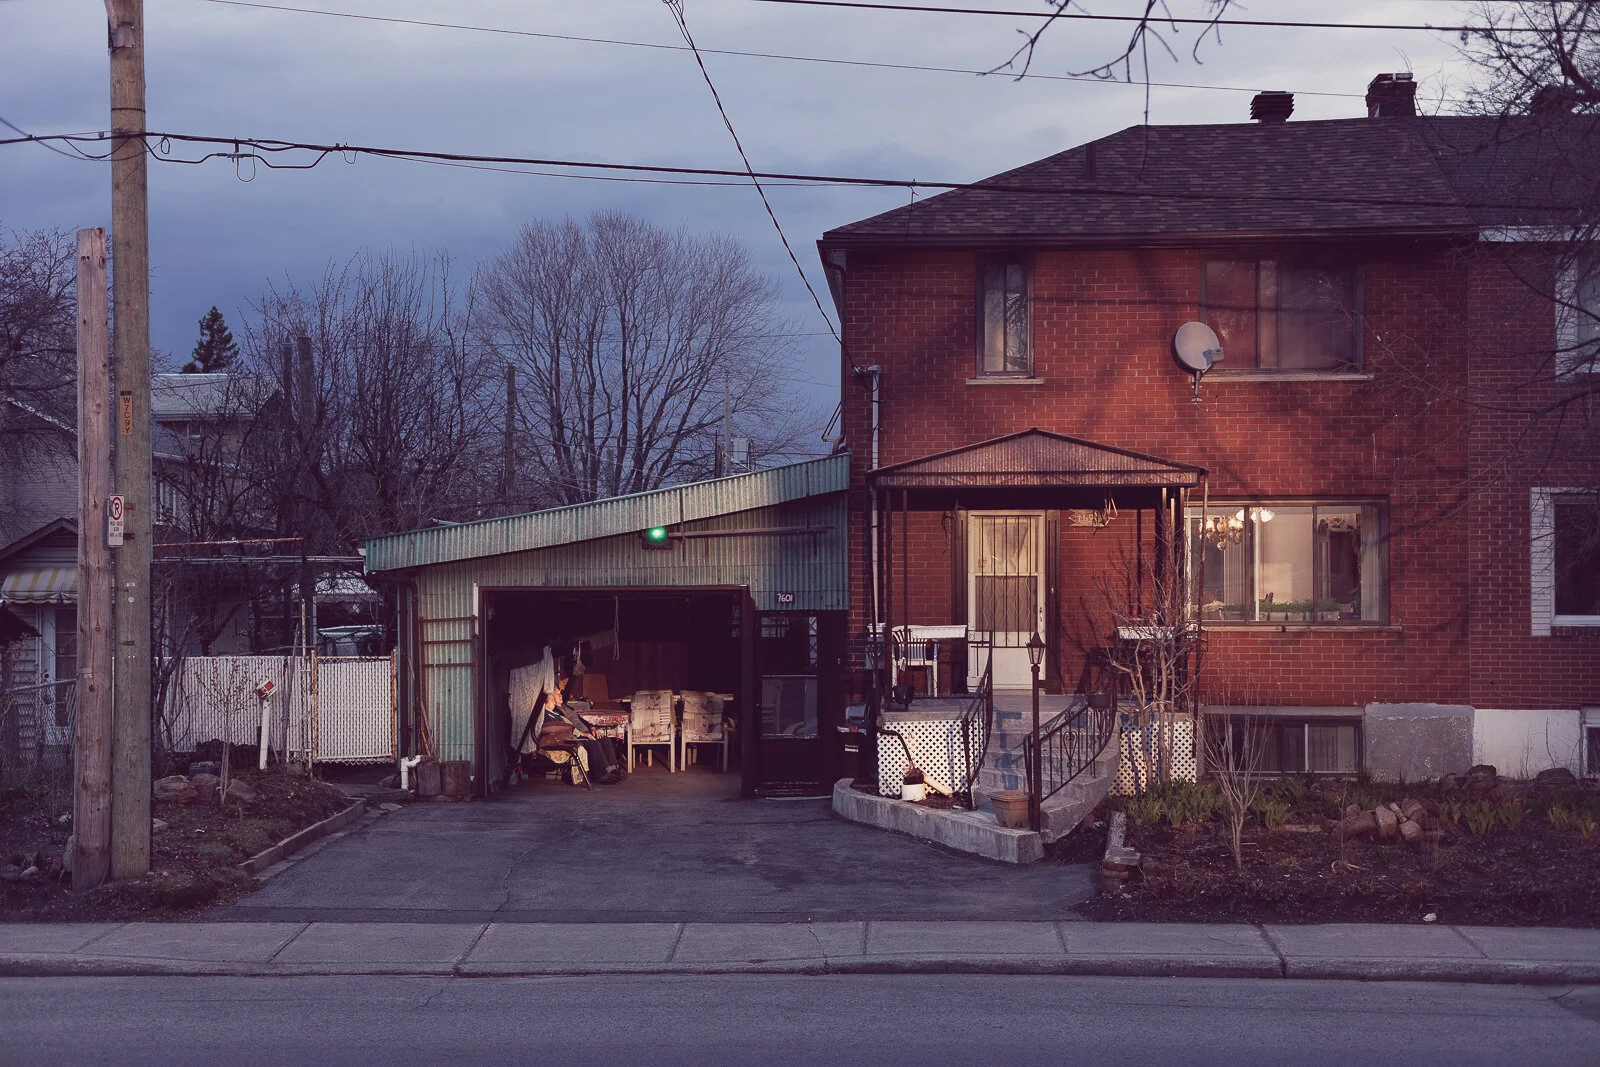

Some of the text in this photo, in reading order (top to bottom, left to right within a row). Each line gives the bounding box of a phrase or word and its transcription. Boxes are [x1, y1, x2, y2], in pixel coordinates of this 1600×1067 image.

[123, 396, 131, 434] W7C9Y
[115, 502, 120, 515] P
[776, 593, 793, 603] 7601
